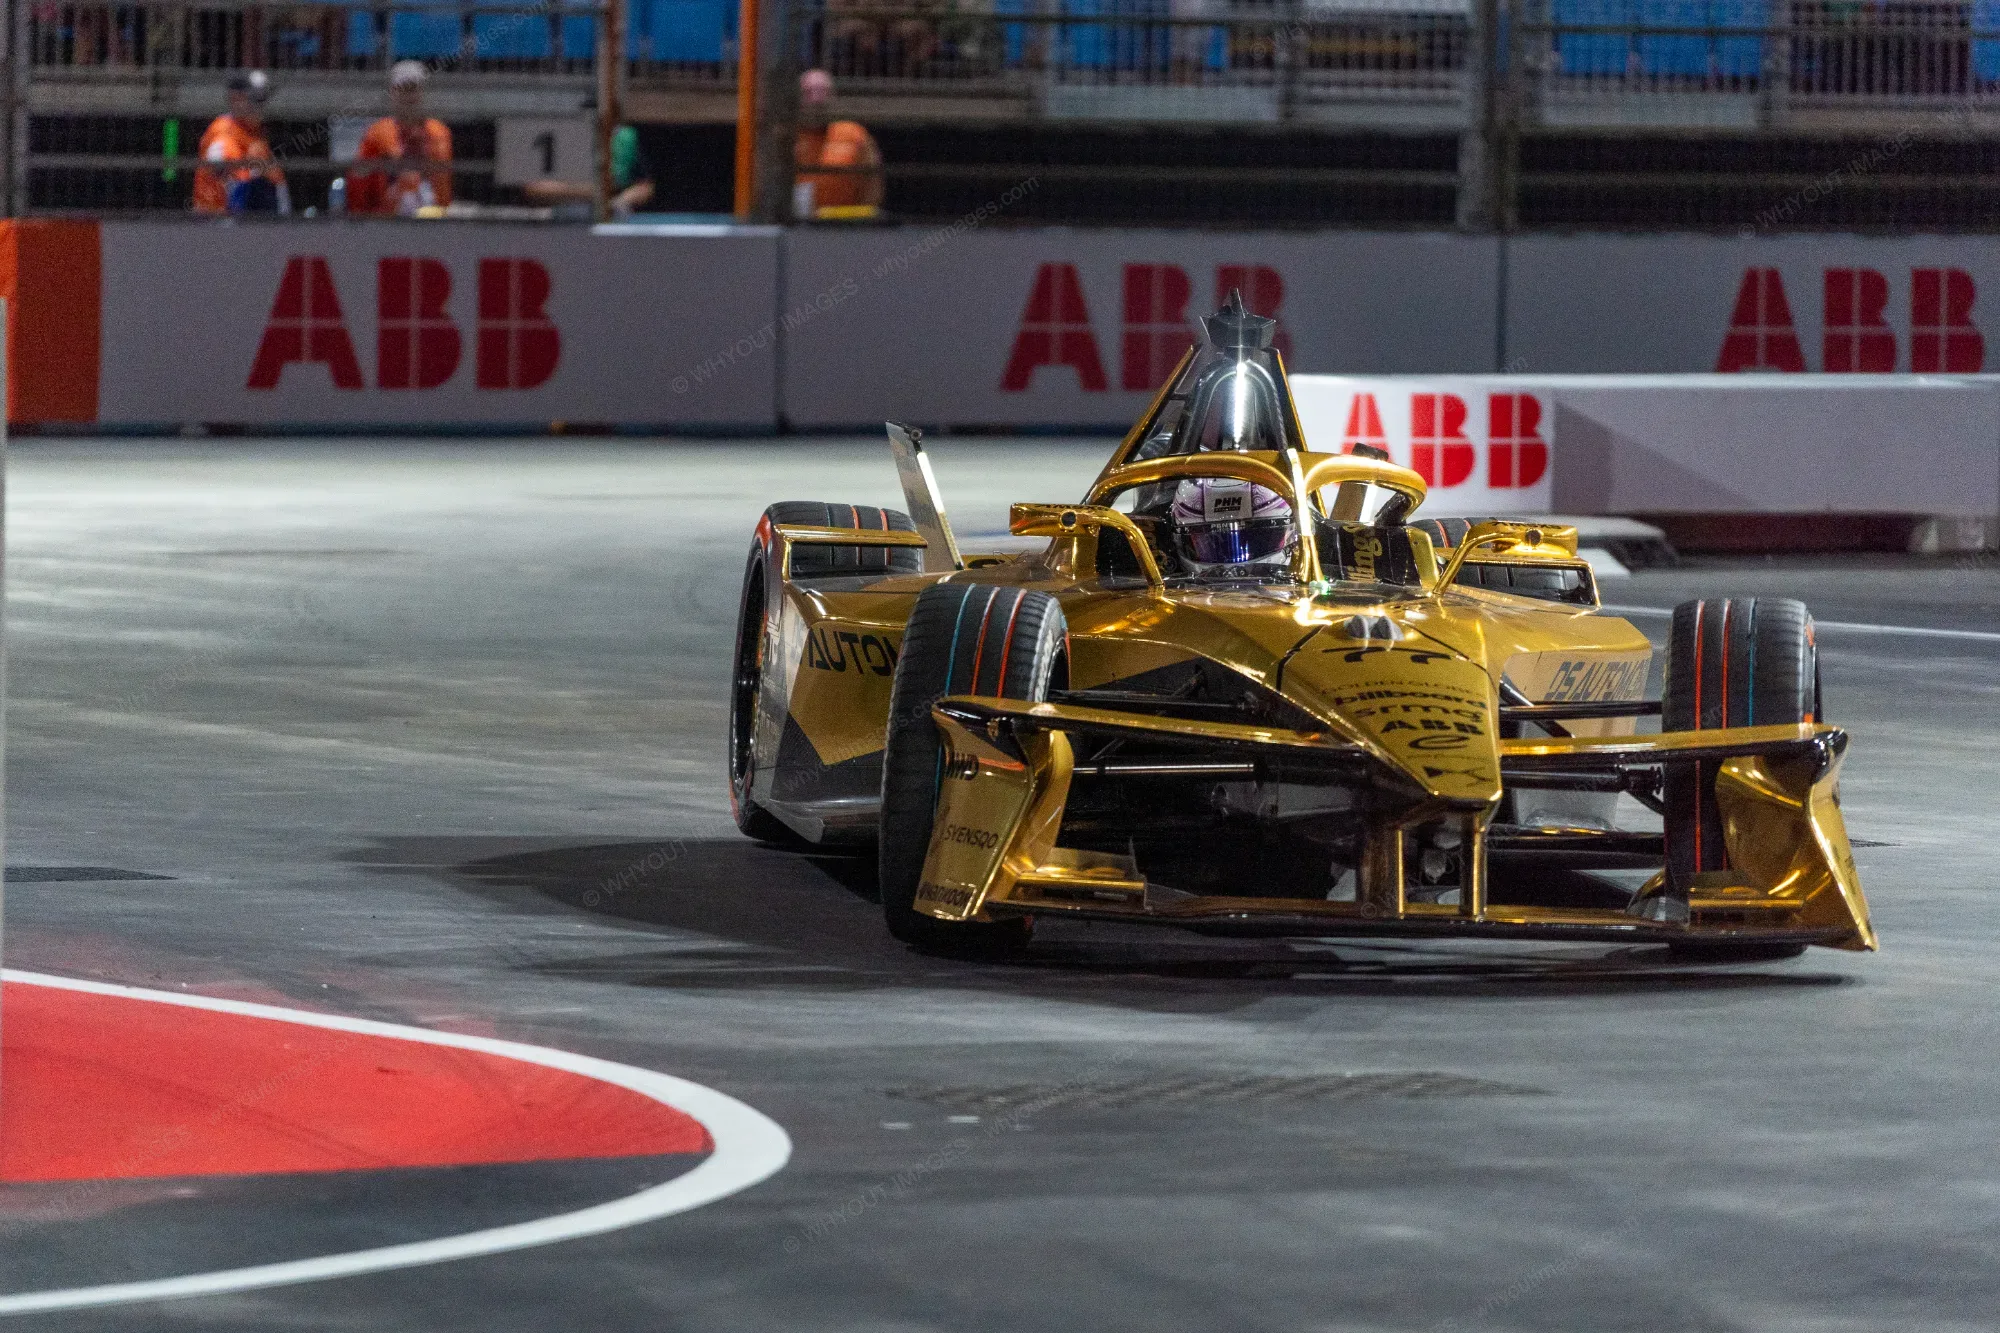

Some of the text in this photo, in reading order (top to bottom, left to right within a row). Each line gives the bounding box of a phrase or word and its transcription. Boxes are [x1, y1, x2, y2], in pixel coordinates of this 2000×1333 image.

[532, 131, 554, 175] 1
[247, 256, 561, 389] ABB
[1714, 266, 1984, 373] ABB
[1335, 393, 1548, 488] ABB
[1335, 690, 1487, 709] billboard
[1381, 719, 1485, 735] ABB
